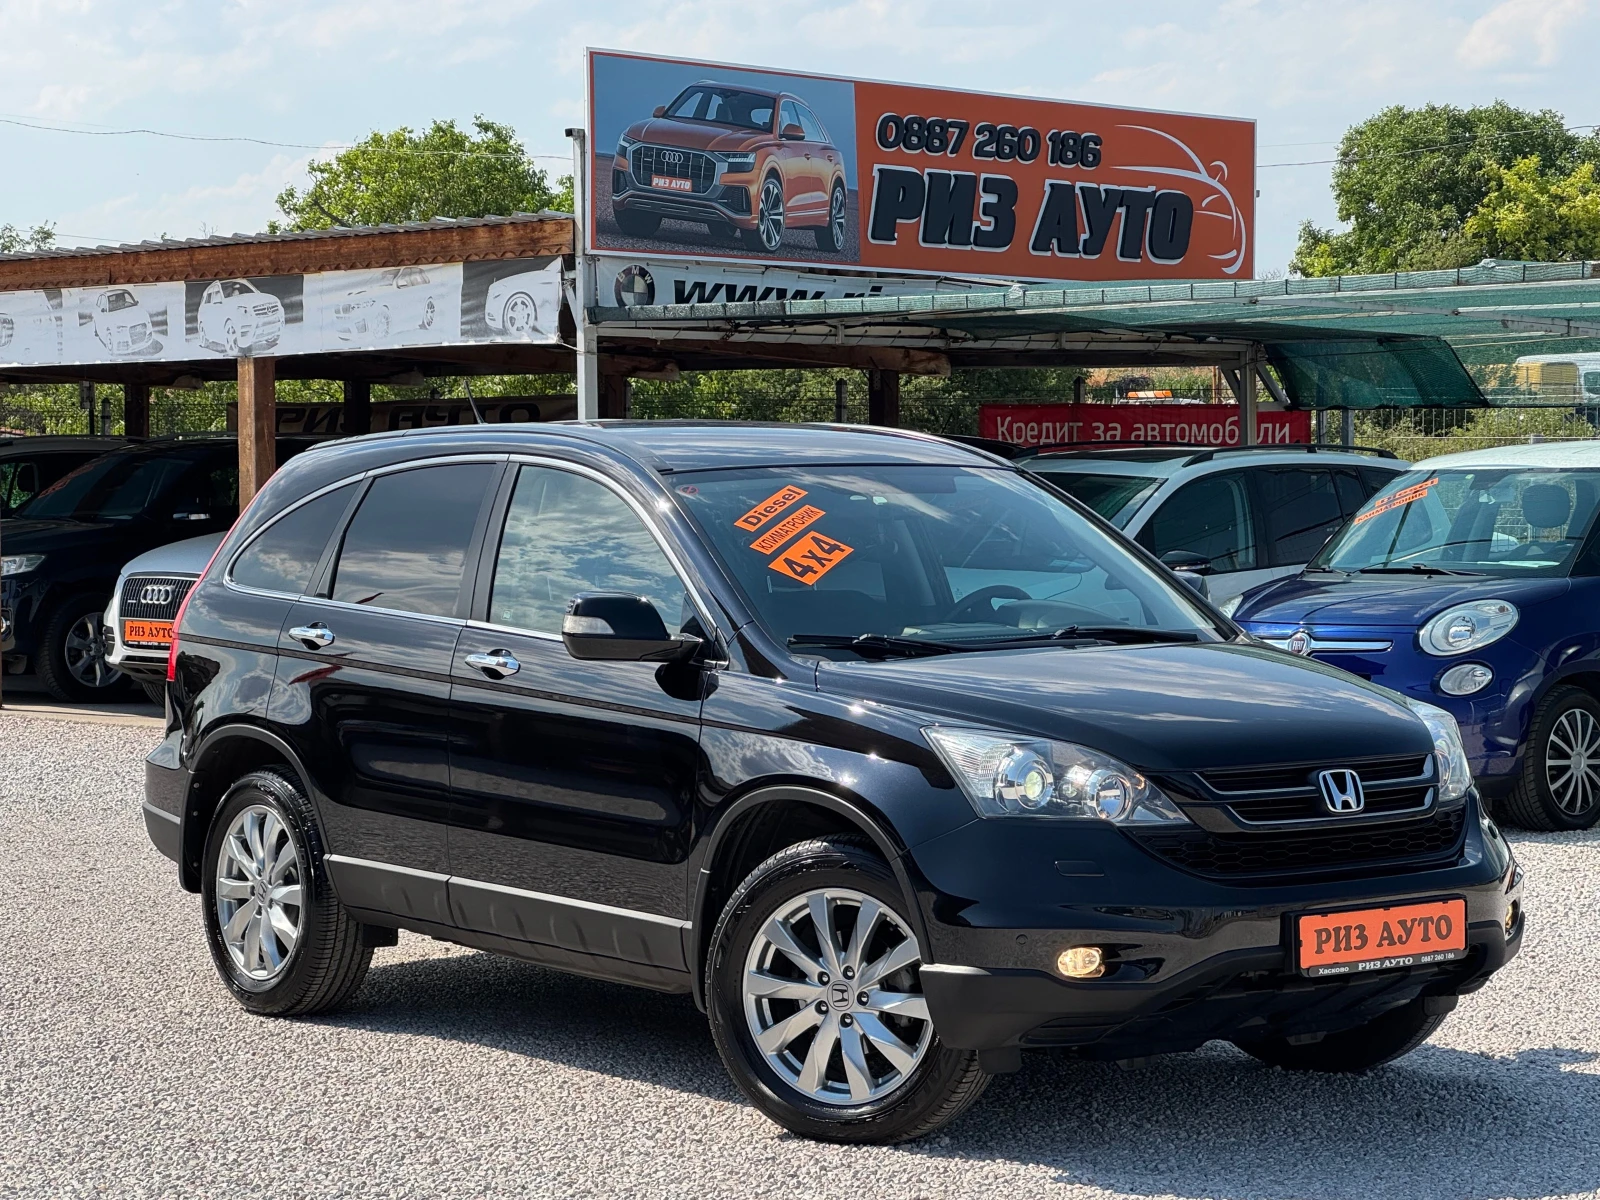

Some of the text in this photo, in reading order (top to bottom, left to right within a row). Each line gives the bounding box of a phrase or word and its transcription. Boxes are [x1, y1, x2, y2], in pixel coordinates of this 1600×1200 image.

[876, 112, 1104, 170] 0887 260 186
[653, 177, 691, 190] РИЗ АУТО
[868, 164, 1194, 265] РИЗ АУТО
[997, 415, 1290, 446] Кредит за автомобли
[742, 487, 802, 526] Diesel
[756, 507, 820, 551] КЛИМАТРОНИК
[129, 625, 146, 637] РИЗ
[1314, 914, 1453, 954] РИЗ АУТО
[1318, 965, 1350, 975] Хасково
[1358, 959, 1381, 971] РИЗ
[1383, 956, 1414, 968] АУТО
